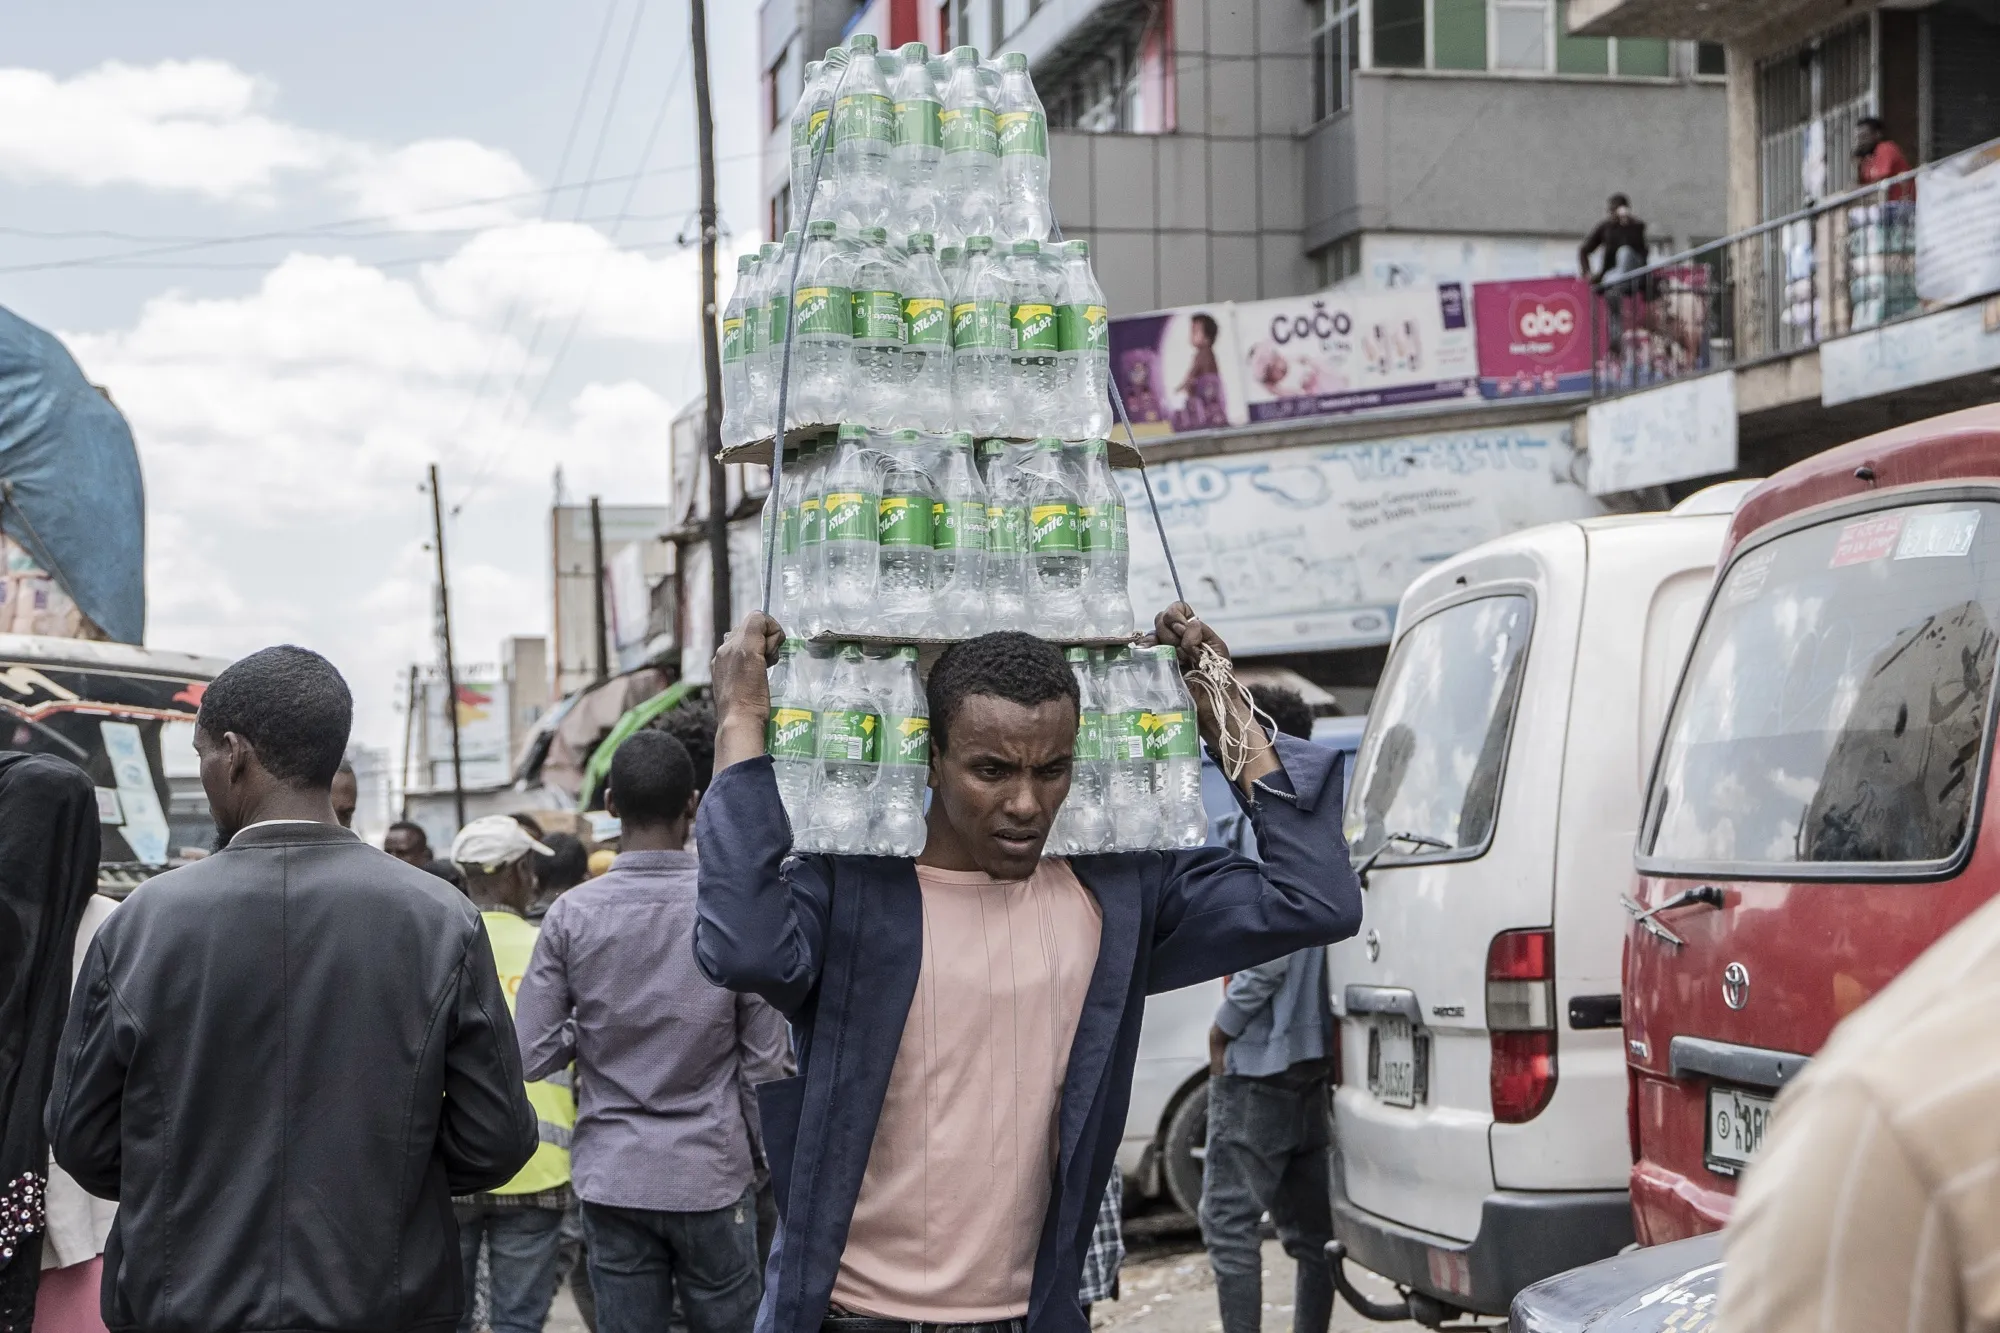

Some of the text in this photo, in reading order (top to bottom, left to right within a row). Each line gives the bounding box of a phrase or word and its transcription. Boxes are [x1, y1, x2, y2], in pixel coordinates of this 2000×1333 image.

[1519, 304, 1575, 338] abc
[1032, 515, 1064, 544] Sprite
[774, 720, 809, 747] Sprite
